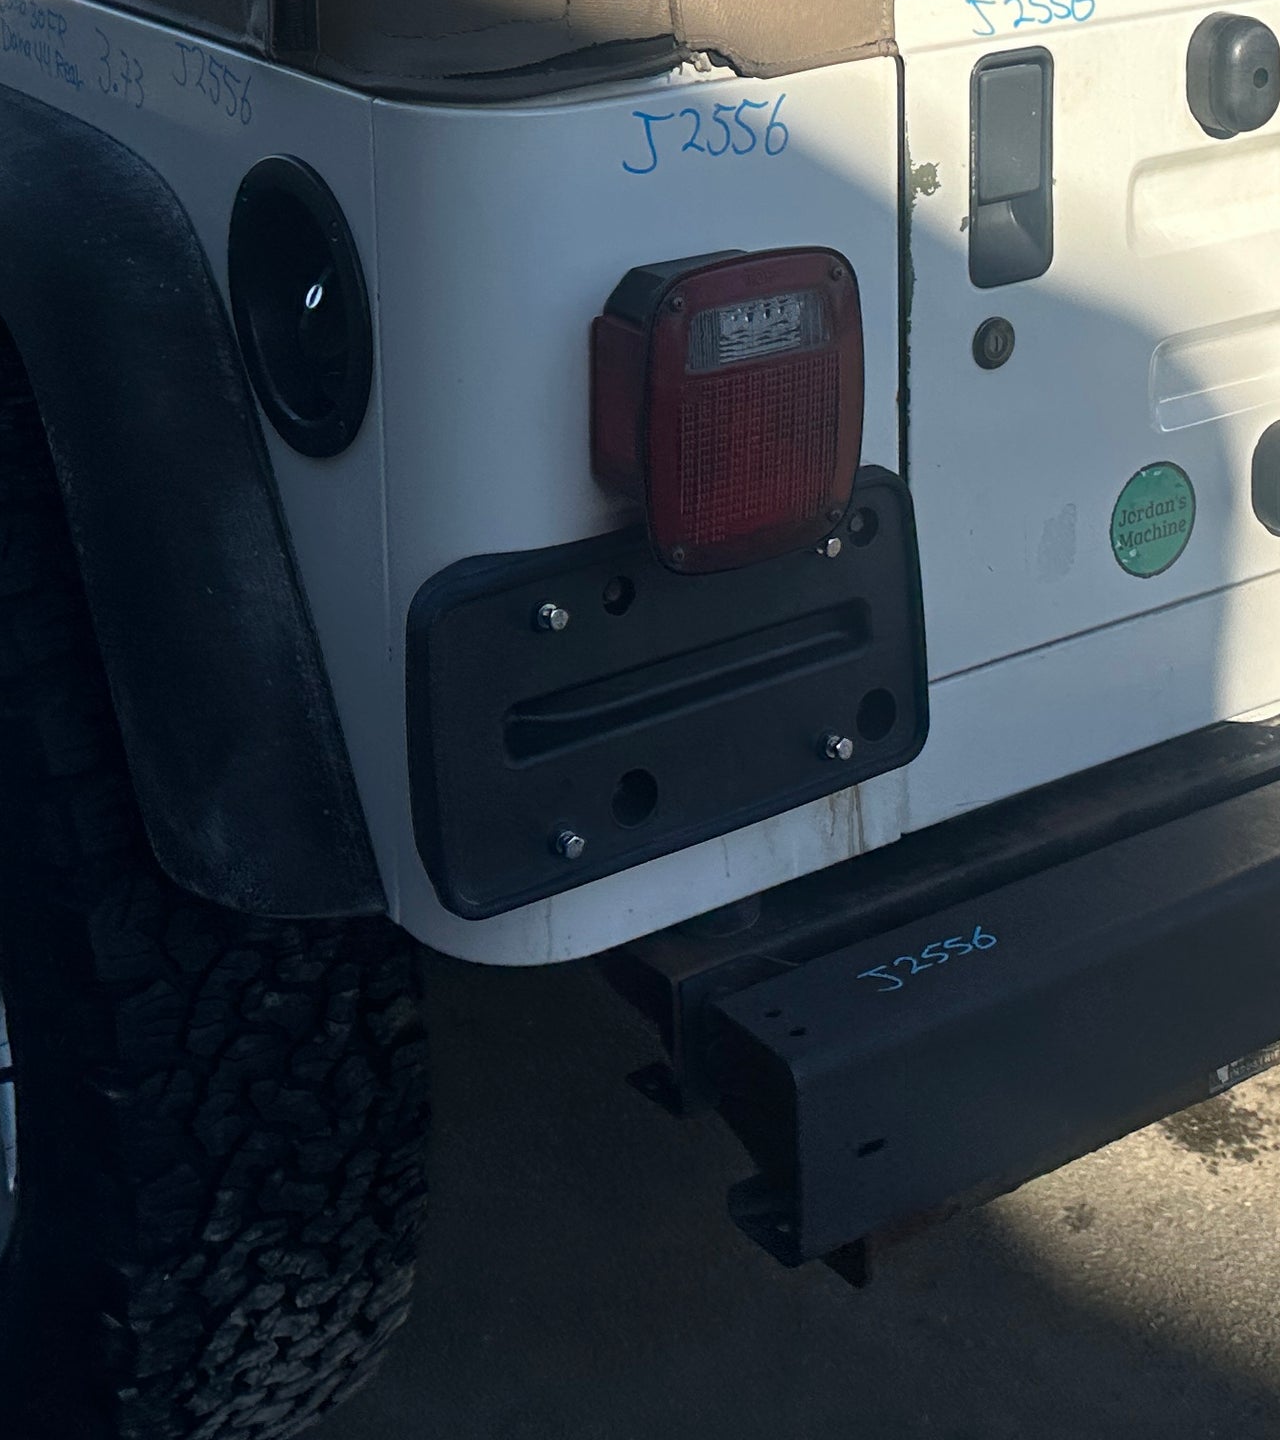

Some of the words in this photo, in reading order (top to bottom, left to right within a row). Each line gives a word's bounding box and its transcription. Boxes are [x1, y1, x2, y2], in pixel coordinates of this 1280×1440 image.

[95, 28, 144, 109] 3.73
[172, 42, 252, 125] J2556
[621, 93, 790, 174] J2556
[1117, 518, 1187, 550] Machine
[1118, 495, 1187, 528] Jordan's
[856, 925, 997, 992] J2556
